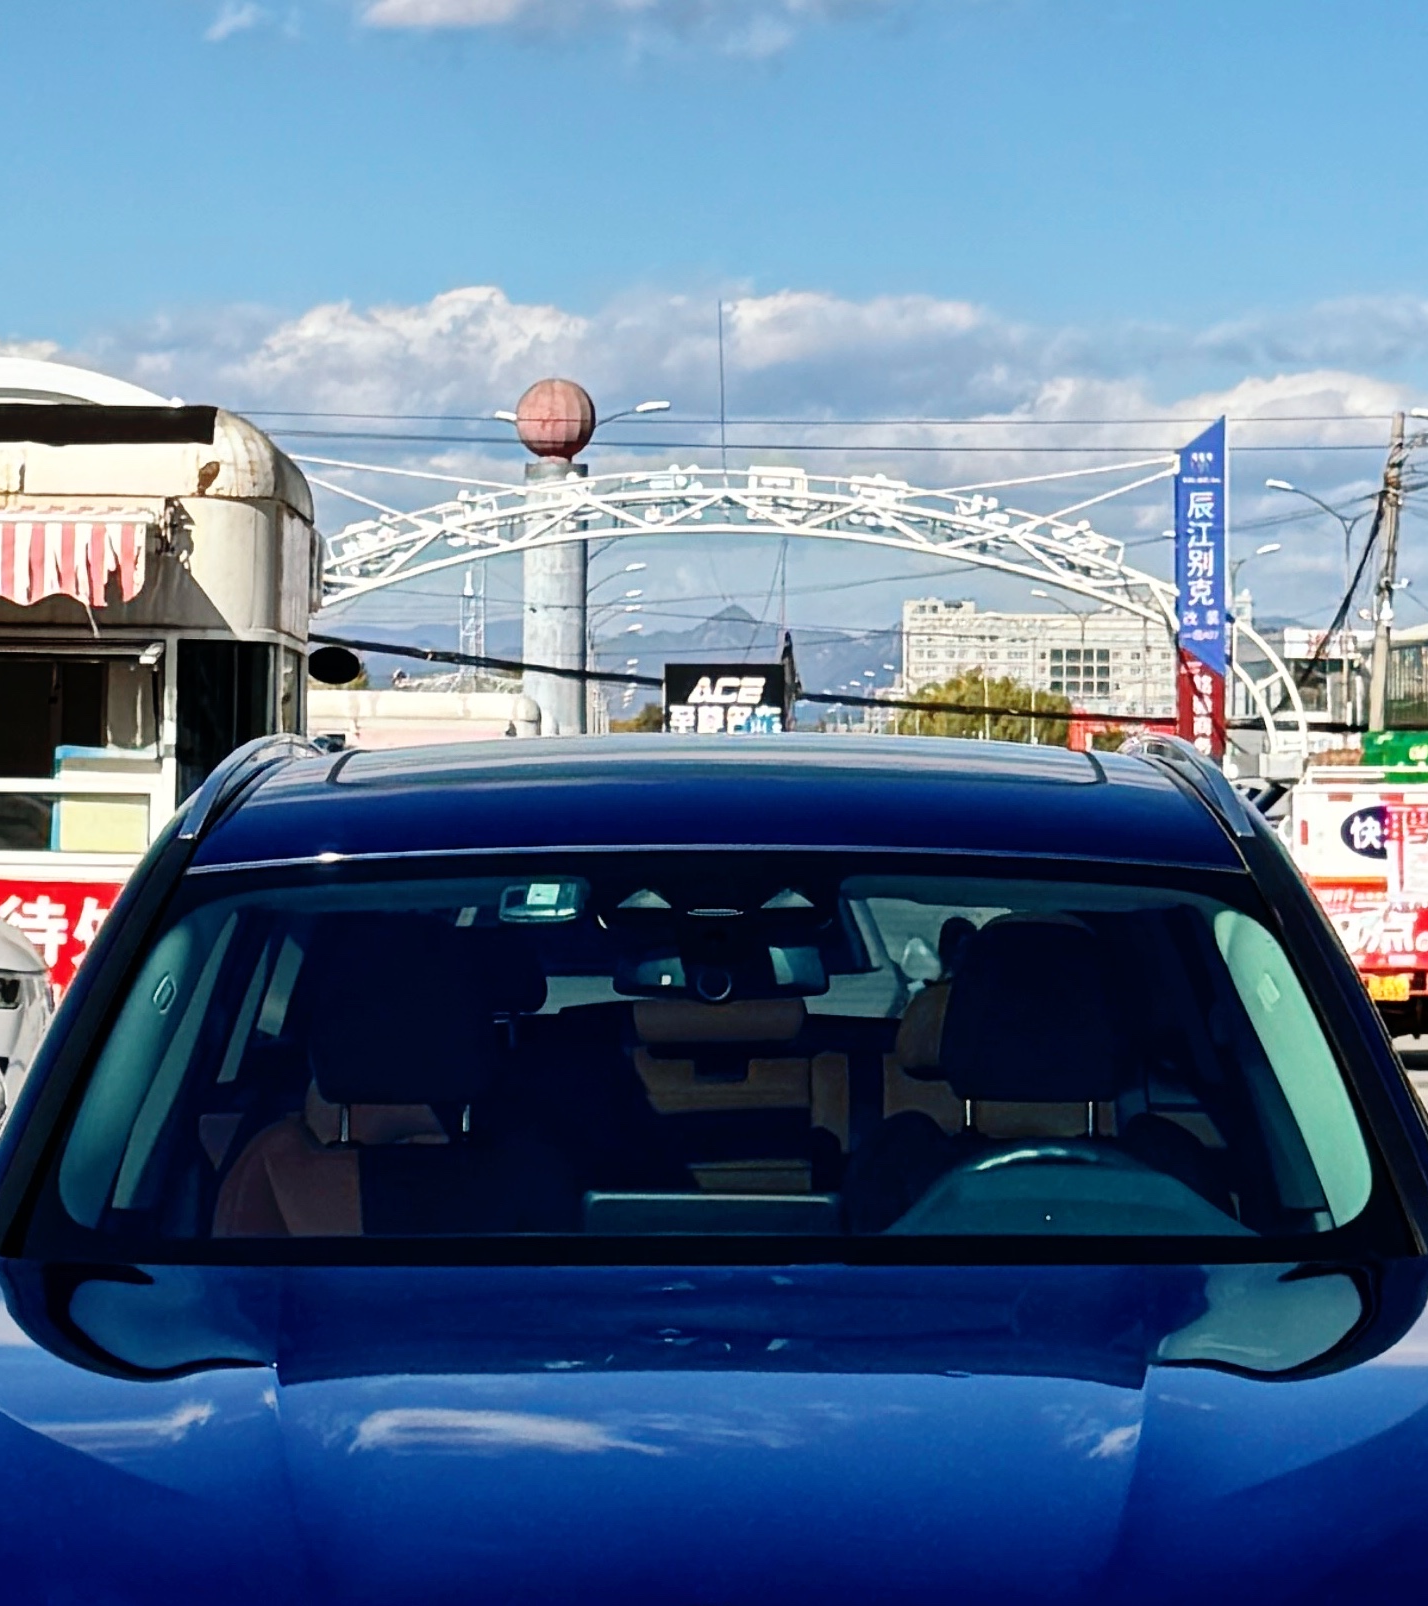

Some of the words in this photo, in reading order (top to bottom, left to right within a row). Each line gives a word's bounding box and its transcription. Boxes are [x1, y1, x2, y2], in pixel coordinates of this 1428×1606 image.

[1187, 491, 1215, 606] 辰江别克
[687, 676, 766, 703] ACE
